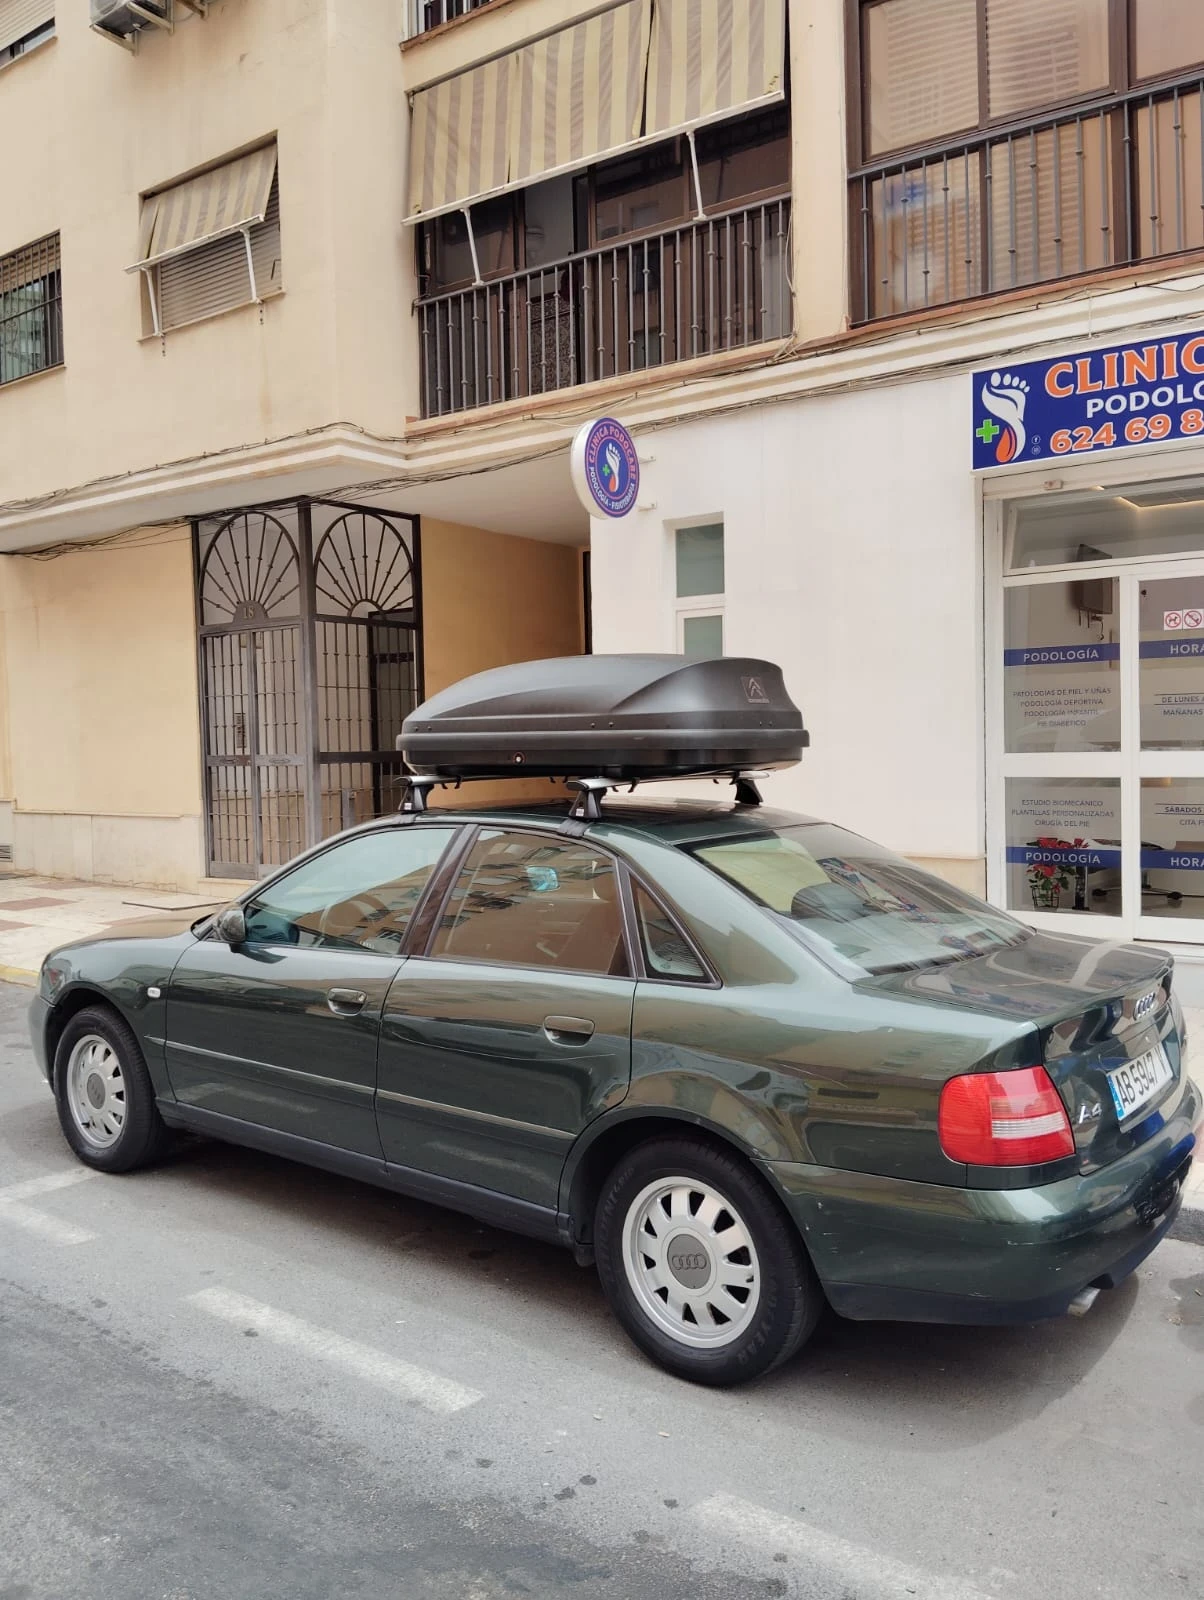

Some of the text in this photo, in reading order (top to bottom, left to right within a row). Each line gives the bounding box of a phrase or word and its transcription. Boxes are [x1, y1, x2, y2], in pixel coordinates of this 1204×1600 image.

[1044, 337, 1204, 398] CLINIC
[1050, 422, 1117, 453] 624
[1125, 414, 1171, 442] 69
[610, 427, 636, 480] PODOCARE
[1023, 648, 1099, 662] PODOLOGÍA
[1026, 852, 1100, 864] PODOLOGÍA
